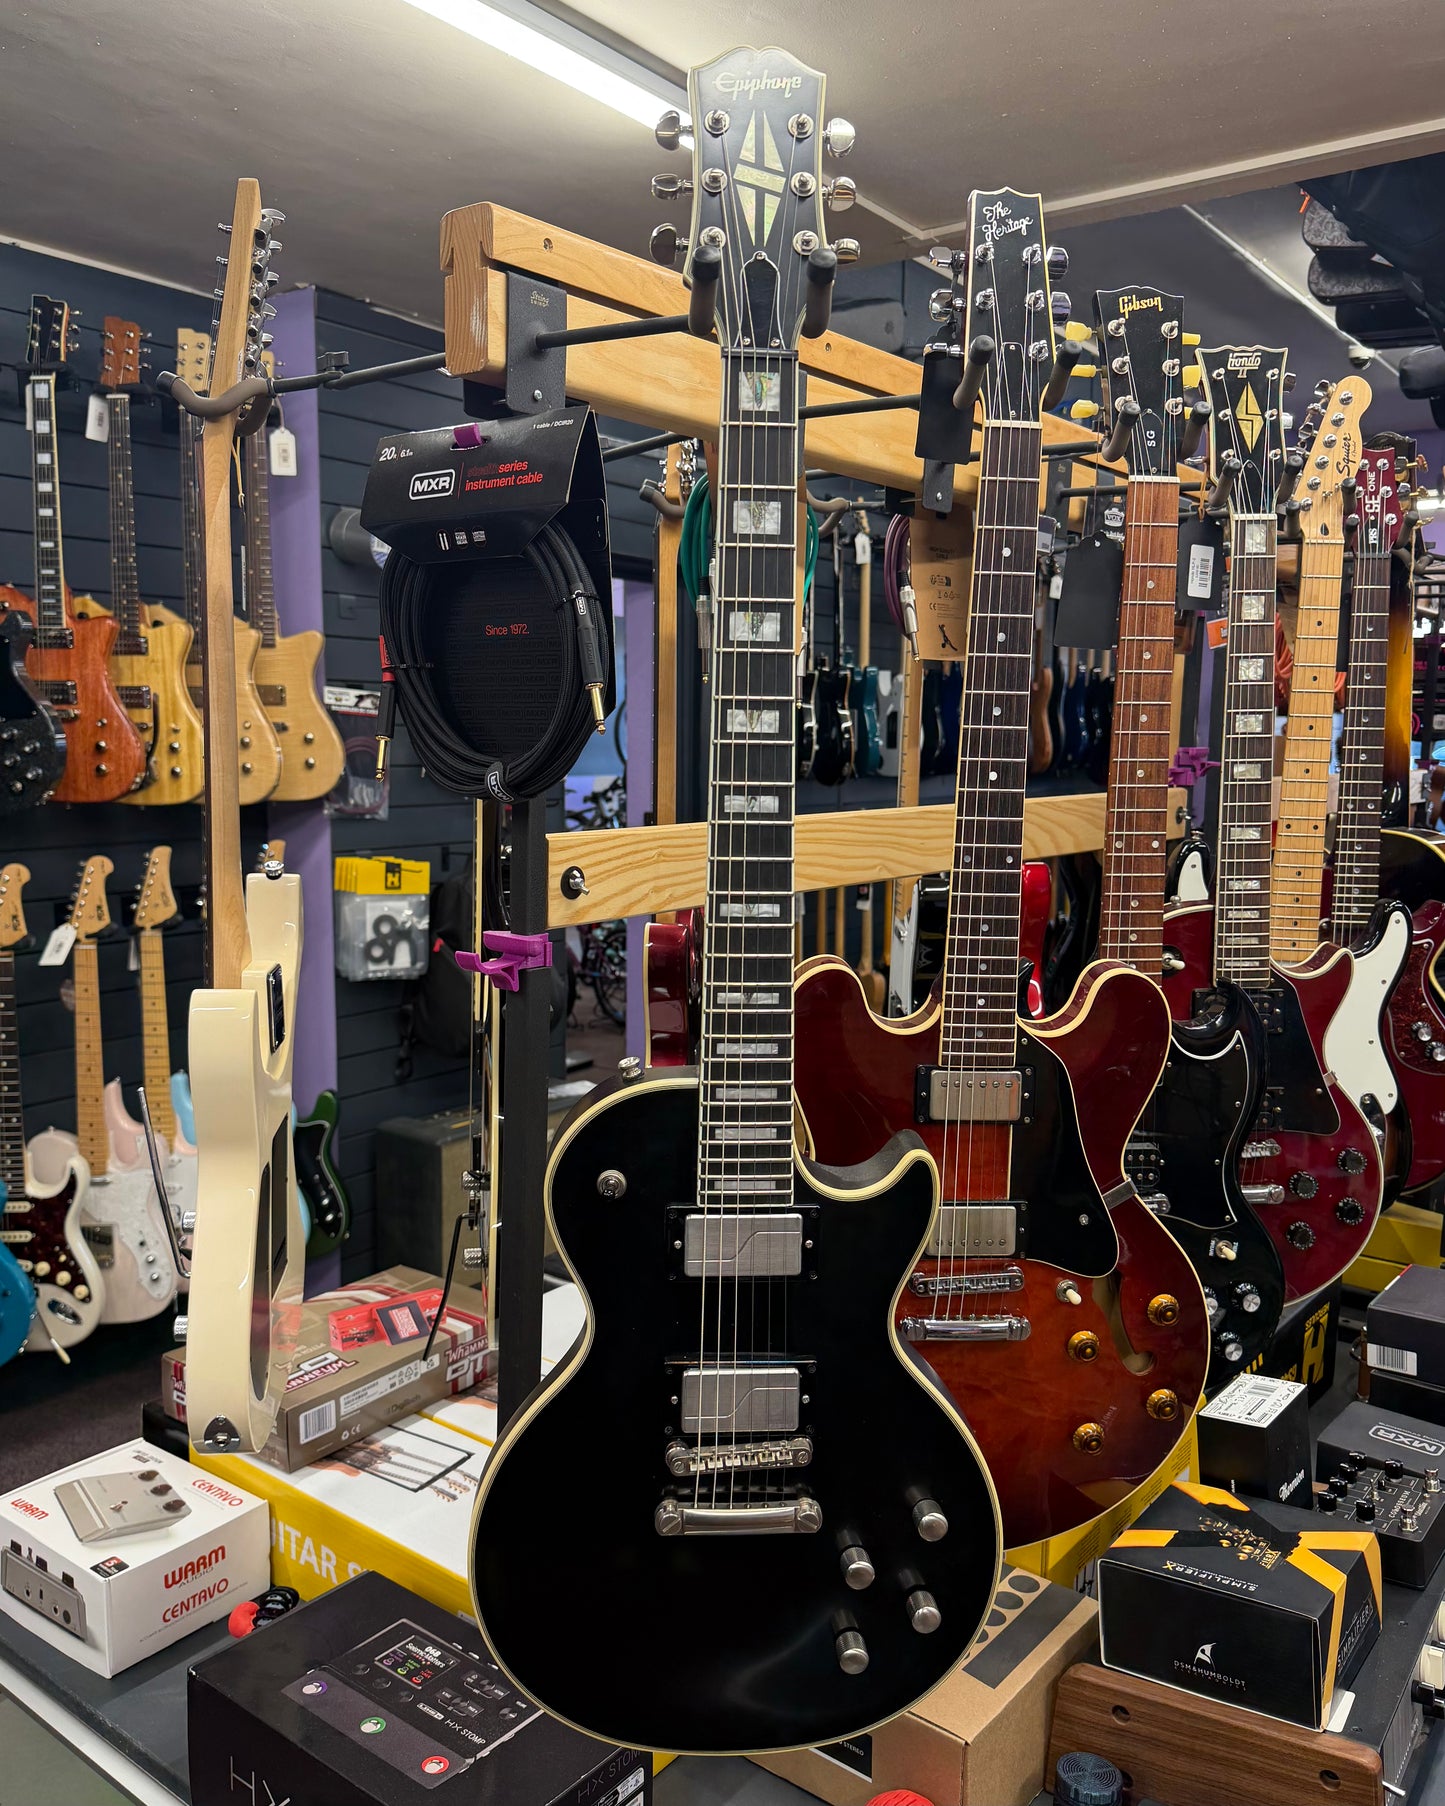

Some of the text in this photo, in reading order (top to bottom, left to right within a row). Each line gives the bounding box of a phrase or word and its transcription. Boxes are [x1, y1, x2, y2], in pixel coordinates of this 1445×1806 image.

[712, 69, 802, 101] Epiphone
[983, 201, 1012, 222] The
[982, 216, 1034, 242] Heritage
[1118, 295, 1164, 320] Gibson
[1146, 430, 1156, 447] SG
[498, 460, 529, 474] series
[1335, 432, 1352, 478] Squier
[413, 476, 451, 493] MXR
[464, 472, 544, 492] instrument cable
[1368, 471, 1376, 492] ONE
[1364, 494, 1380, 513] SE
[485, 623, 530, 636] Since 1972.
[490, 774, 510, 801] MXR
[1376, 1428, 1438, 1453] MXR
[191, 1478, 244, 1508] CENTAVO
[10, 1497, 50, 1521] WARM
[163, 1544, 227, 1590] WARM
[162, 1577, 230, 1624] CENTAVO
[444, 1718, 487, 1745] HX STOMP
[843, 1741, 865, 1756] STEREO
